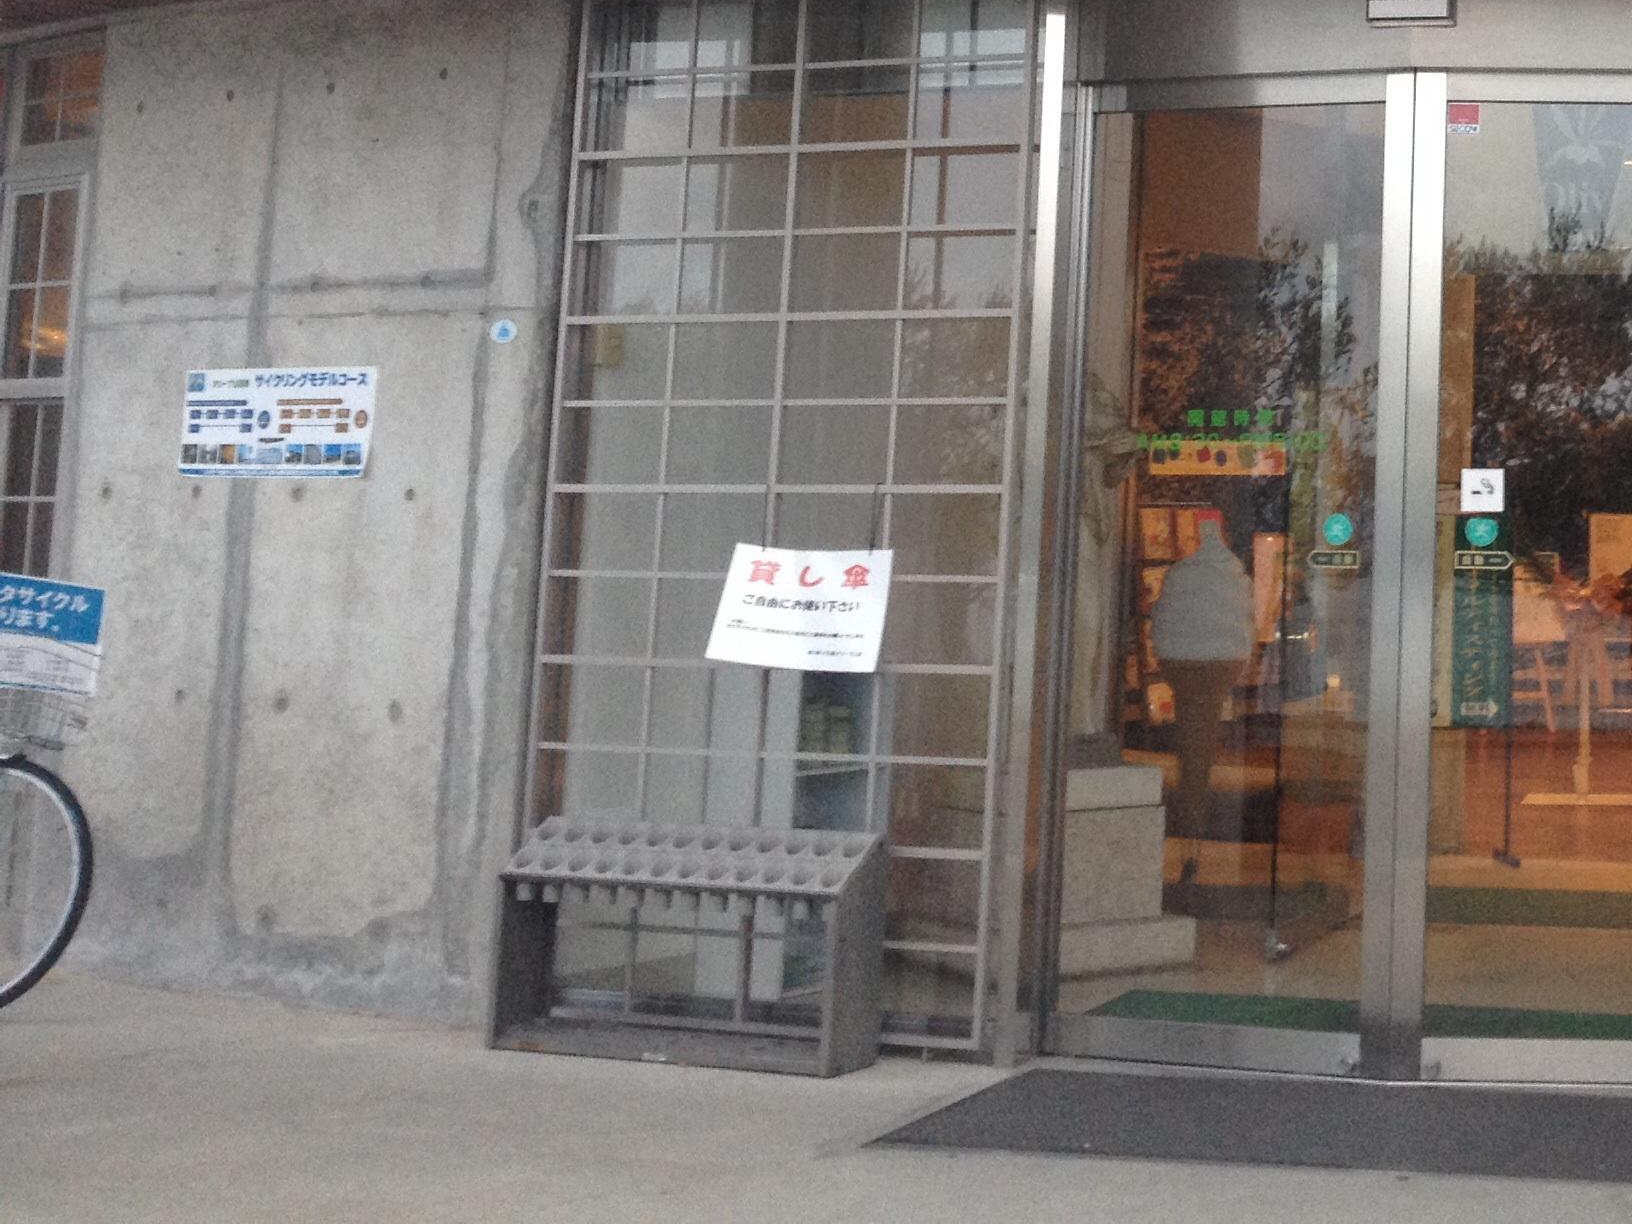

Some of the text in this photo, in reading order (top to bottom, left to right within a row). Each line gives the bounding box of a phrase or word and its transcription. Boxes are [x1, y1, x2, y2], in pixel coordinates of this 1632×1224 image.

[255, 373, 367, 388] サイクリングモデルコース
[748, 560, 871, 589] 貸し傘
[742, 594, 860, 613] ご自由にお使い下さい
